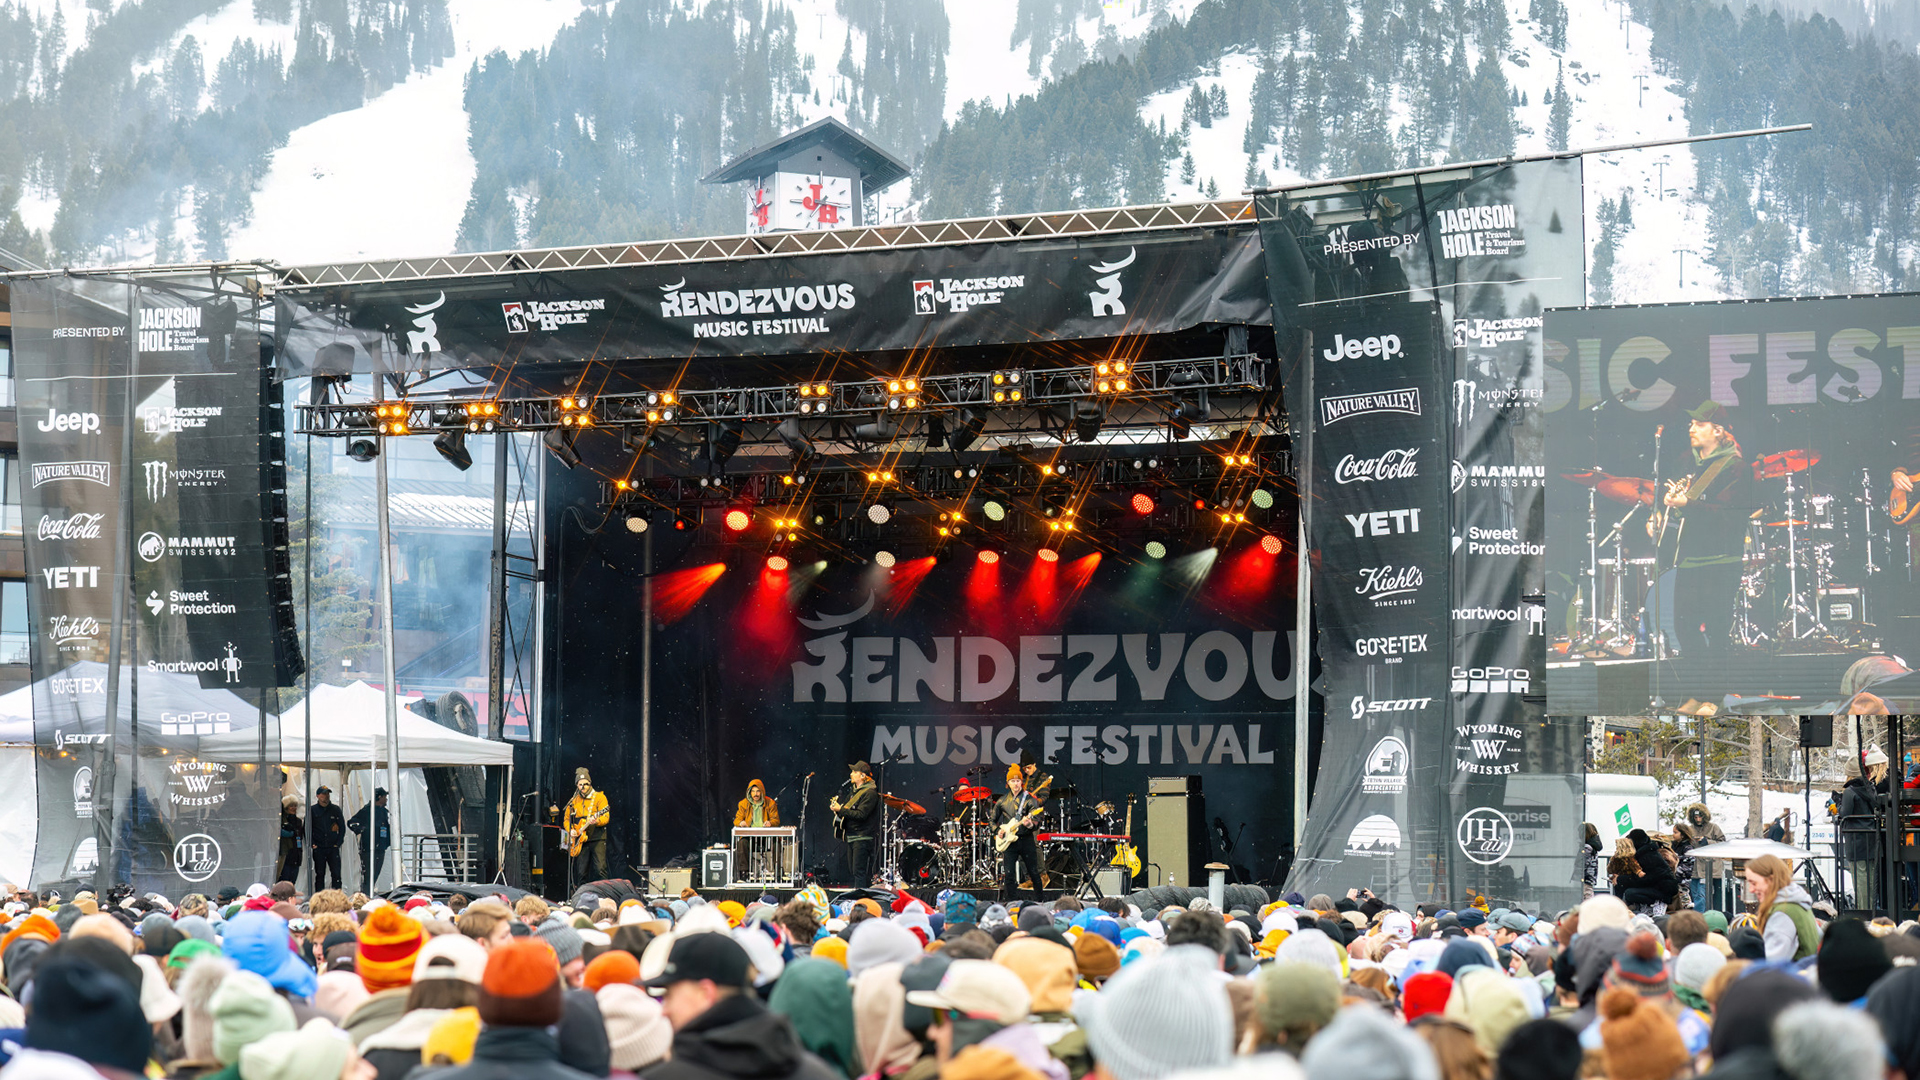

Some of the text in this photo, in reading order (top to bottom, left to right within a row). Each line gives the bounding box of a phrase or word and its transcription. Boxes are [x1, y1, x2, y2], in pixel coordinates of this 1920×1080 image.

[1437, 204, 1515, 234] JACKSON
[1323, 233, 1420, 256] PRESENTED BY
[1485, 230, 1511, 239] Travel
[1493, 239, 1526, 247] Tourism
[1441, 232, 1485, 259] HOLE
[1485, 246, 1509, 255] Board
[659, 280, 856, 318] RENDEZVOUS
[935, 275, 1024, 303] JACKSON
[525, 299, 605, 323] JACKSON
[950, 292, 1001, 312] HOLE
[139, 307, 201, 329] JACKSON
[541, 313, 588, 331] HOLE
[694, 317, 829, 338] MUSIC FESTIVAL
[1468, 316, 1543, 339] JACKSON
[53, 326, 125, 338] PRESENTED BY
[139, 331, 172, 352] HOLE
[1480, 331, 1525, 348] HOLE
[160, 407, 222, 424] JACKSON
[1326, 391, 1417, 421] NATURE VALLEY
[169, 418, 206, 432] HOLE
[35, 464, 107, 484] NATURE VALLEY
[170, 469, 226, 480] MONSTER
[1335, 448, 1420, 484] Coca-Cola
[38, 513, 105, 541] Coca-Cola
[1345, 508, 1419, 538] YETI
[1469, 526, 1518, 540] Sweet
[168, 537, 235, 548] MAMMUT
[43, 567, 98, 589] YETI
[1355, 565, 1423, 594] Kiehl's
[170, 590, 209, 602] Sweet
[170, 602, 236, 615] Protection
[49, 615, 99, 640] Kiehl's
[1355, 634, 1428, 657] GORE-TEX
[148, 658, 219, 672] Smartwool
[1452, 666, 1530, 680] GoPro
[1366, 698, 1432, 712] SCOTT
[161, 712, 230, 723] GoPro
[1456, 724, 1522, 739] WYOMING
[870, 723, 1274, 766] MUSIC FESTIVAL
[169, 762, 227, 775] WYOMING
[1457, 758, 1519, 775] WHISKEY
[170, 793, 226, 806] WHISKEY
[1461, 818, 1502, 846] JH
[176, 843, 211, 868] JH
